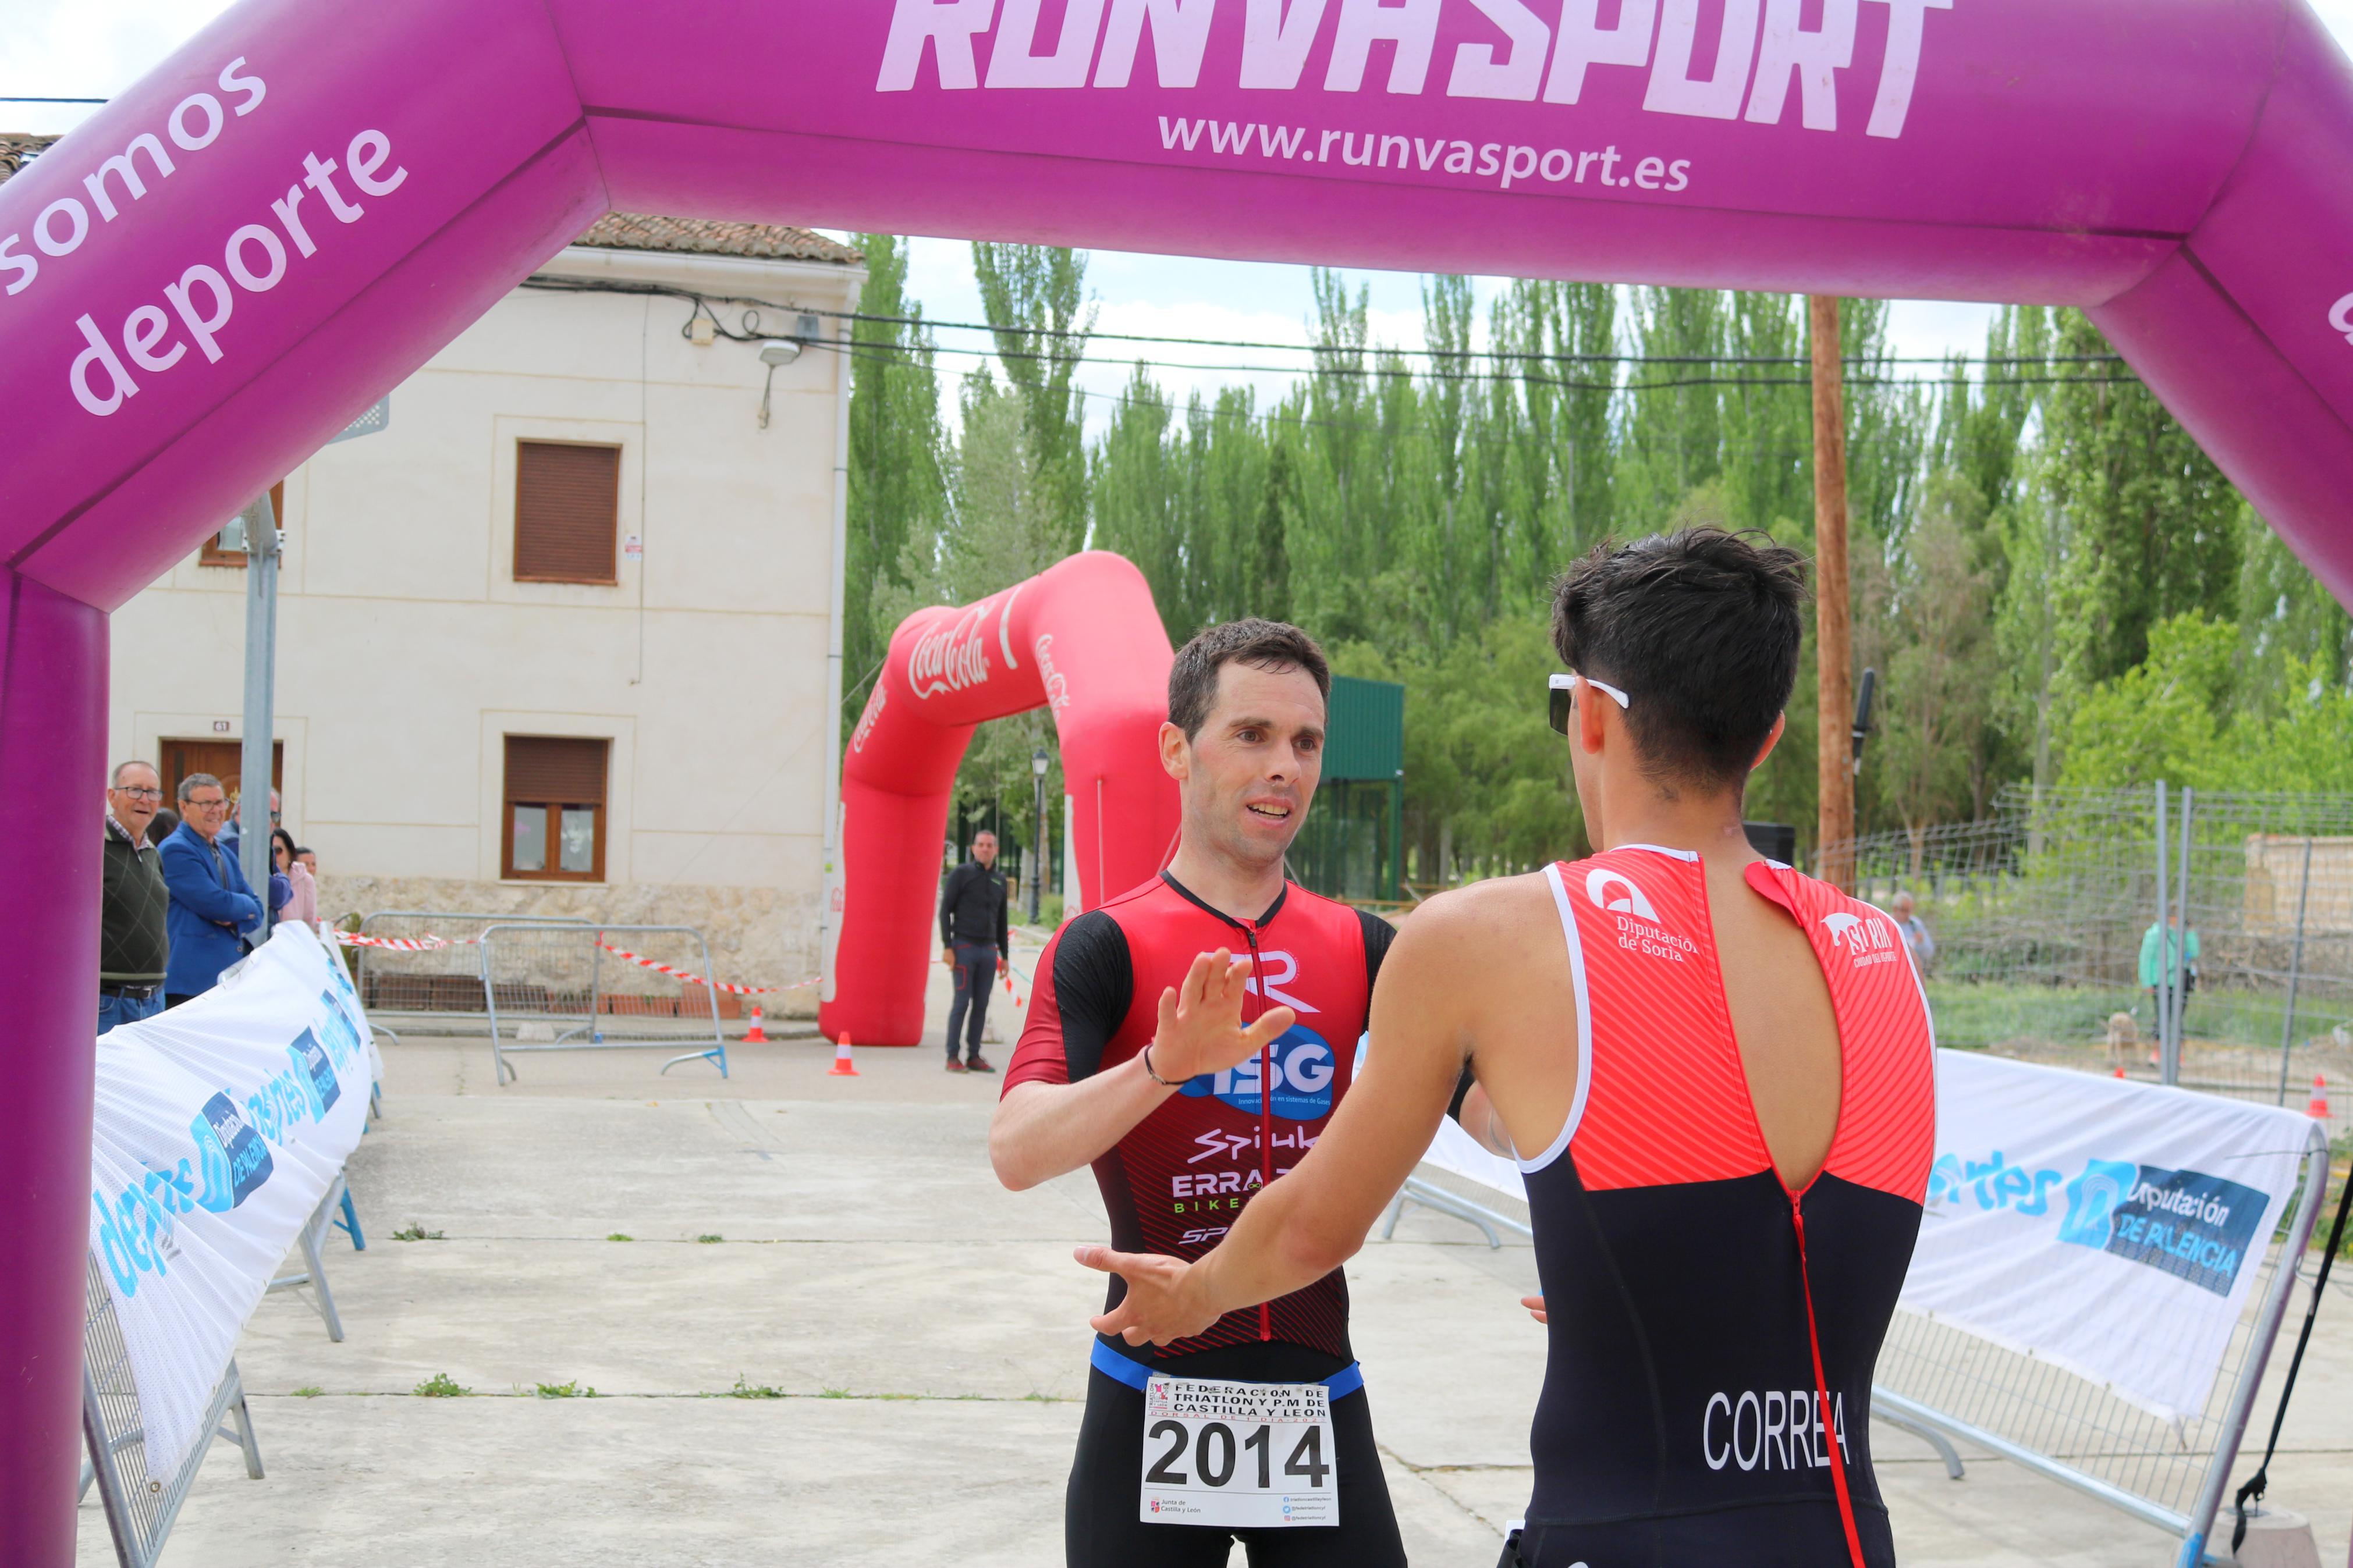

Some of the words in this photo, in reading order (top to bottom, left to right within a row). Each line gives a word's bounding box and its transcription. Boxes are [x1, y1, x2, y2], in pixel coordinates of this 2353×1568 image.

[1158, 116, 1691, 193] www.runvasport.es
[0, 56, 267, 296] somos
[69, 129, 409, 417] deporte
[1618, 932, 1637, 951] de
[1641, 938, 1684, 963] Soria
[1286, 1096, 1309, 1104] sistemas
[1316, 1097, 1331, 1105] Gases
[2117, 1213, 2148, 1244] DE
[1174, 1393, 1253, 1406] TRIATLON
[1259, 1398, 1267, 1406] Y
[1273, 1399, 1299, 1407] P.M
[1305, 1389, 1324, 1398] DE
[1151, 1411, 1209, 1419] DORSAL
[1174, 1403, 1258, 1416] CASTILLA
[1266, 1408, 1276, 1416] Y
[1283, 1409, 1326, 1417] LEON
[1703, 1390, 1852, 1471] CORREA
[1145, 1420, 1330, 1488] 2014
